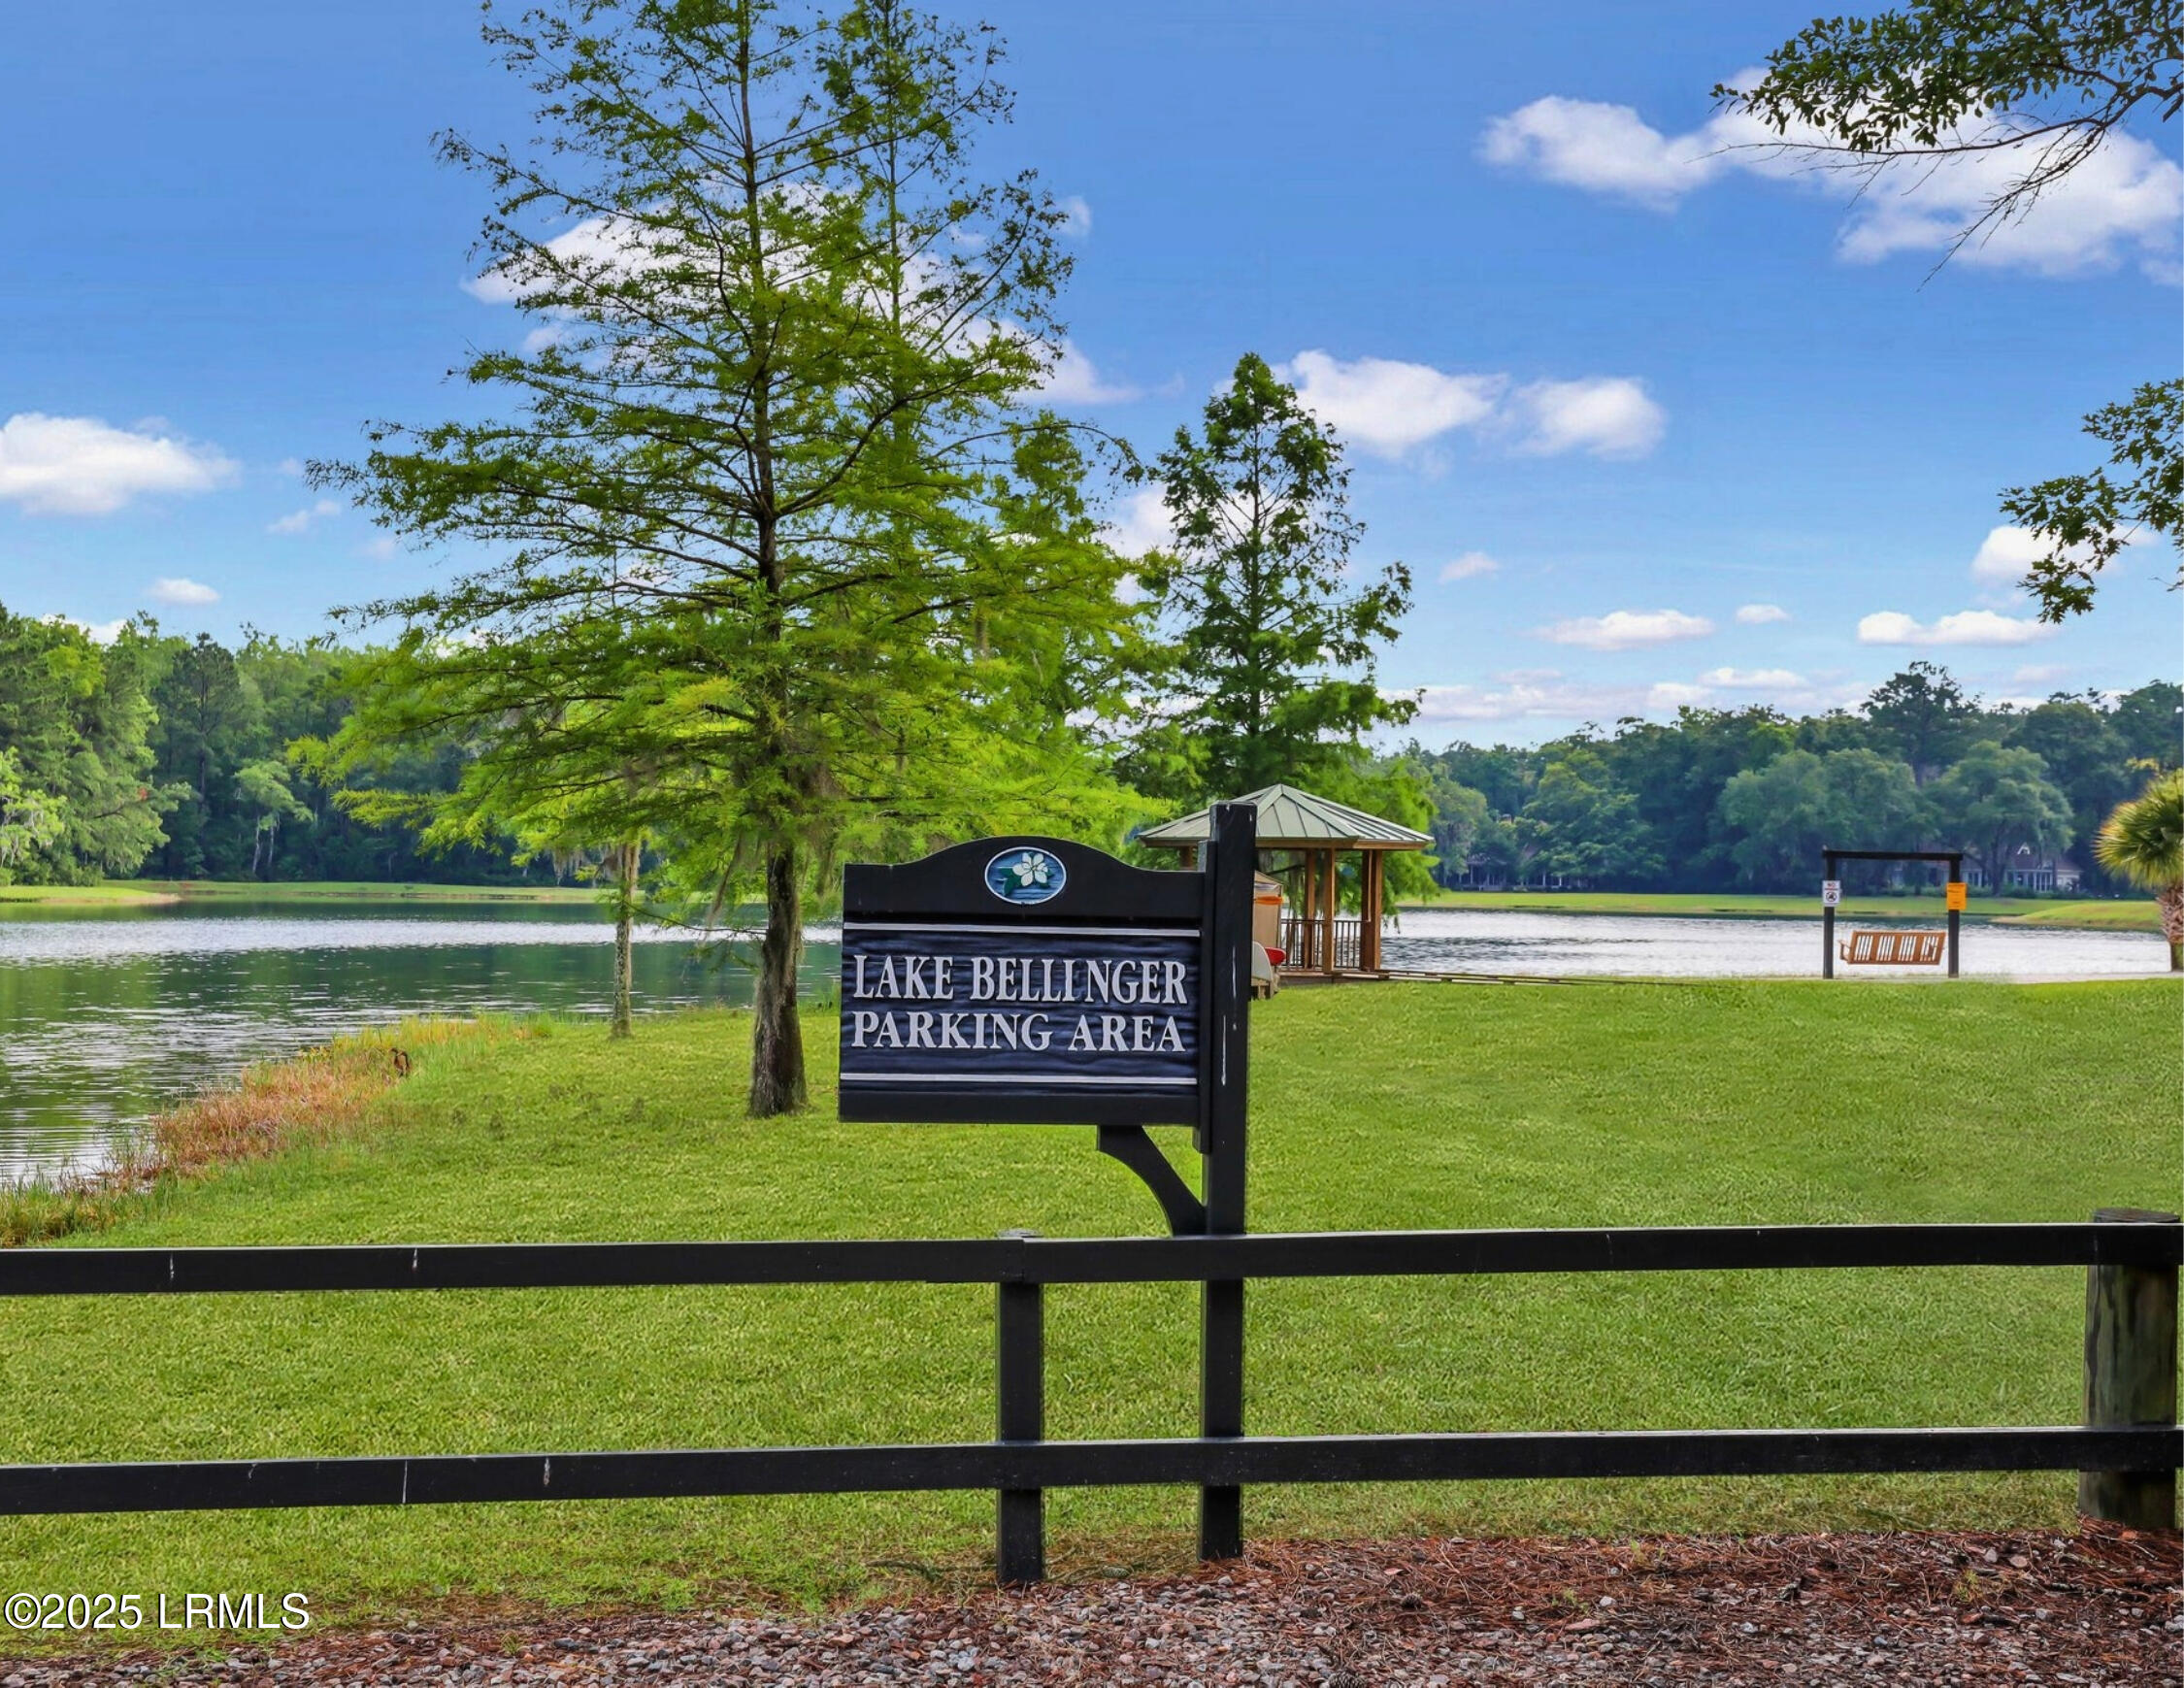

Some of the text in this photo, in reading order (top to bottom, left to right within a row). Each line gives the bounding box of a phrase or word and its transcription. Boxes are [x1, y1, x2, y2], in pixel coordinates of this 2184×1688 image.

[852, 954, 1188, 1006] LAKE BELLINGER
[851, 1010, 1186, 1053] PARKING AREA
